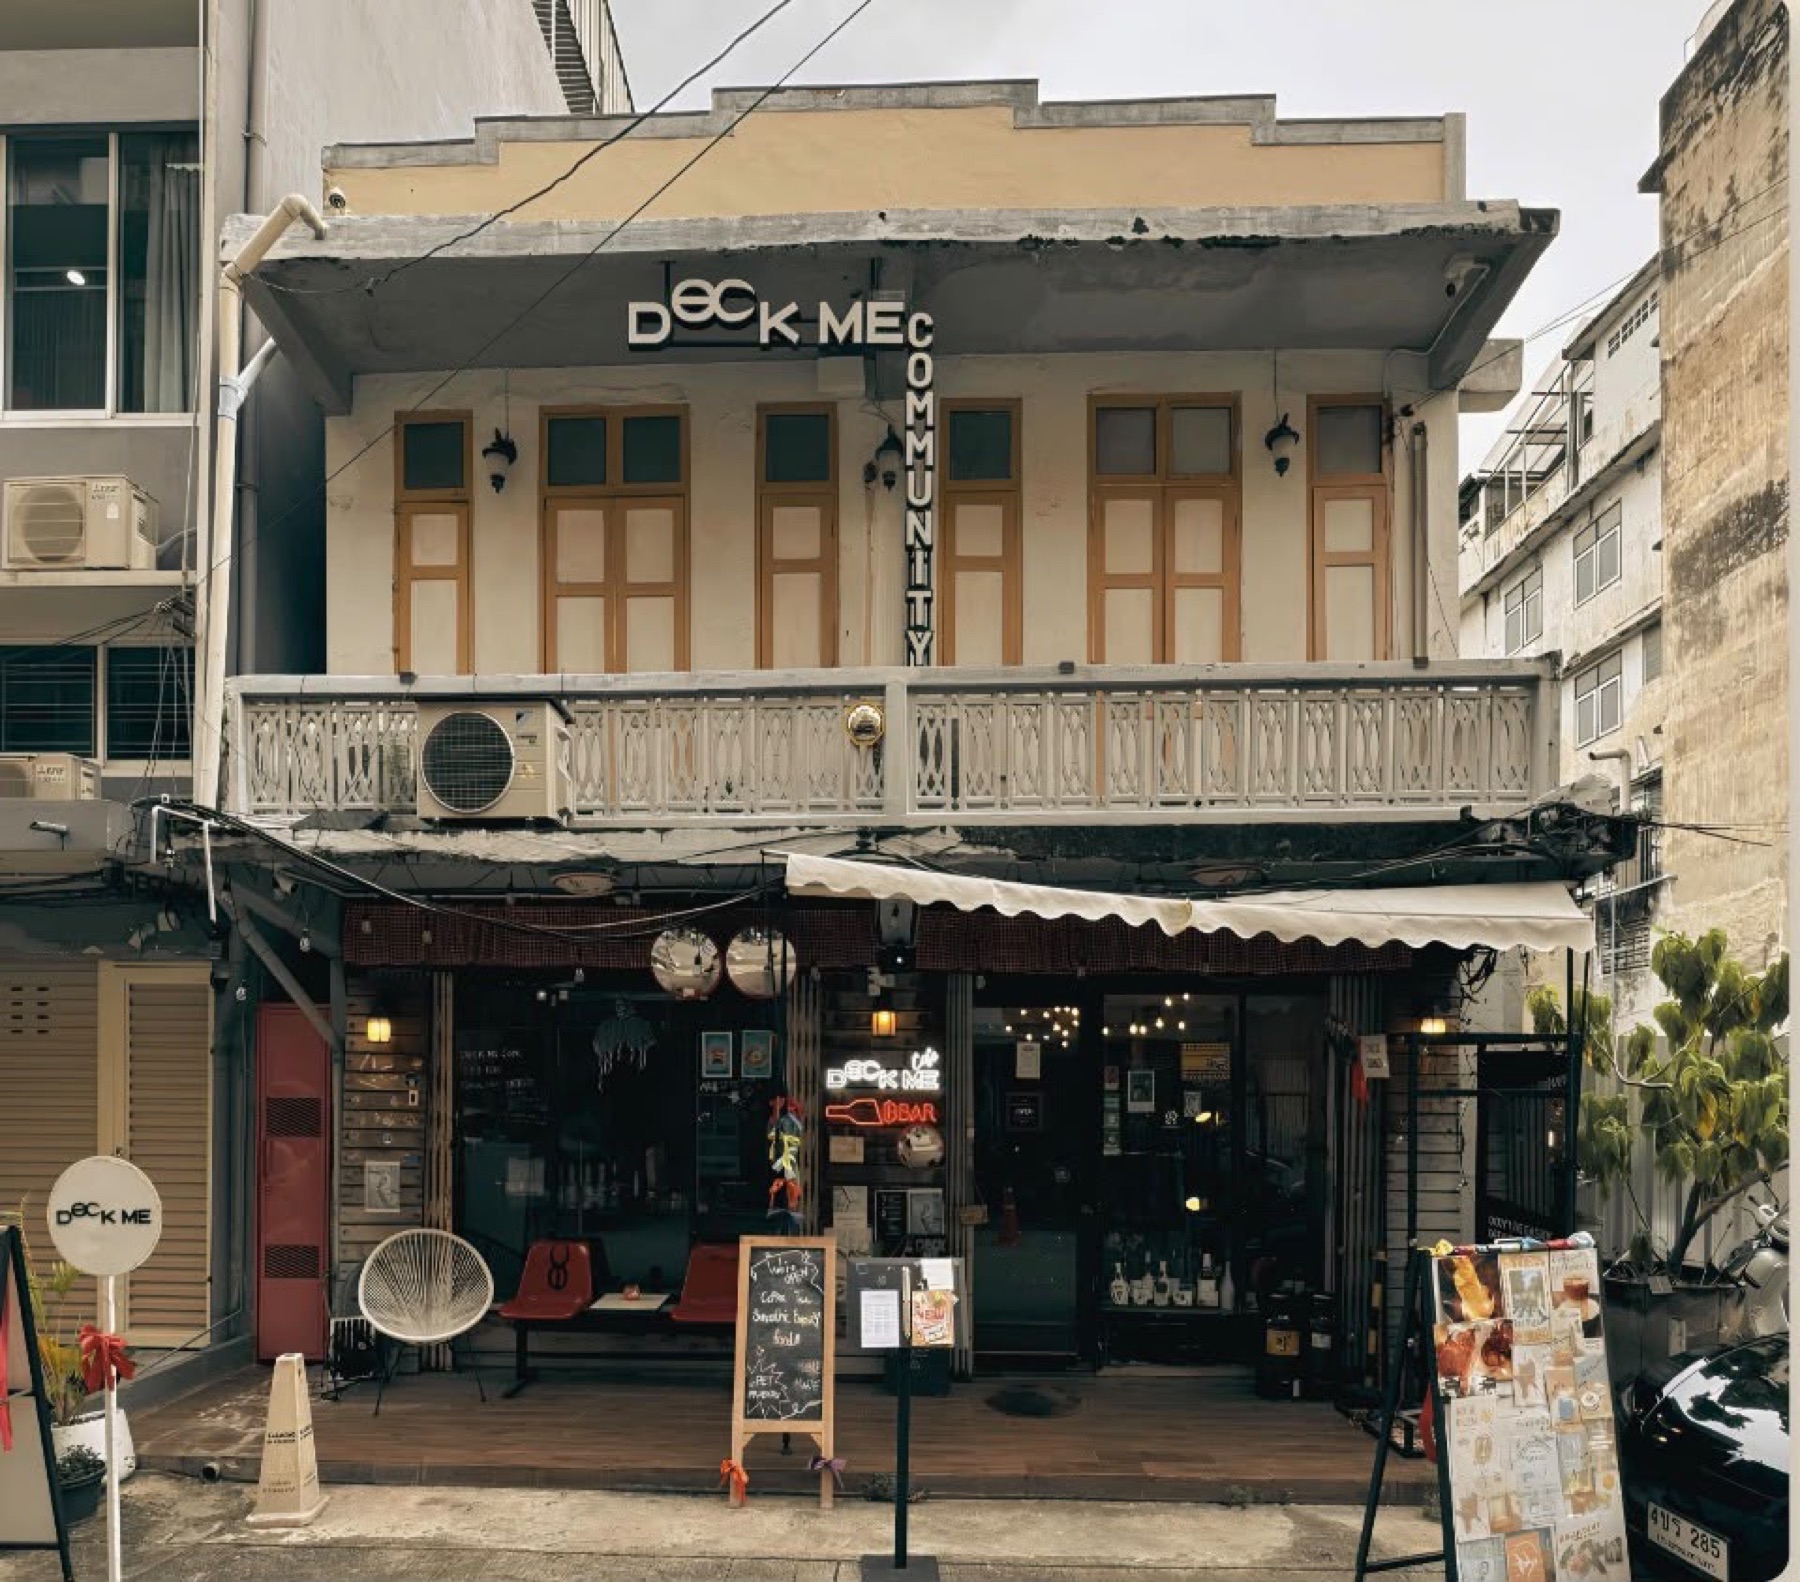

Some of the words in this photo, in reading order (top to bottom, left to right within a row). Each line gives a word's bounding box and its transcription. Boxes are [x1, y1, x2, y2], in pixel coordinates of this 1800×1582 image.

[819, 301, 905, 345] ME
[902, 1069, 940, 1091] ME
[122, 1208, 152, 1226] ME
[1690, 1527, 1720, 1559] 285
